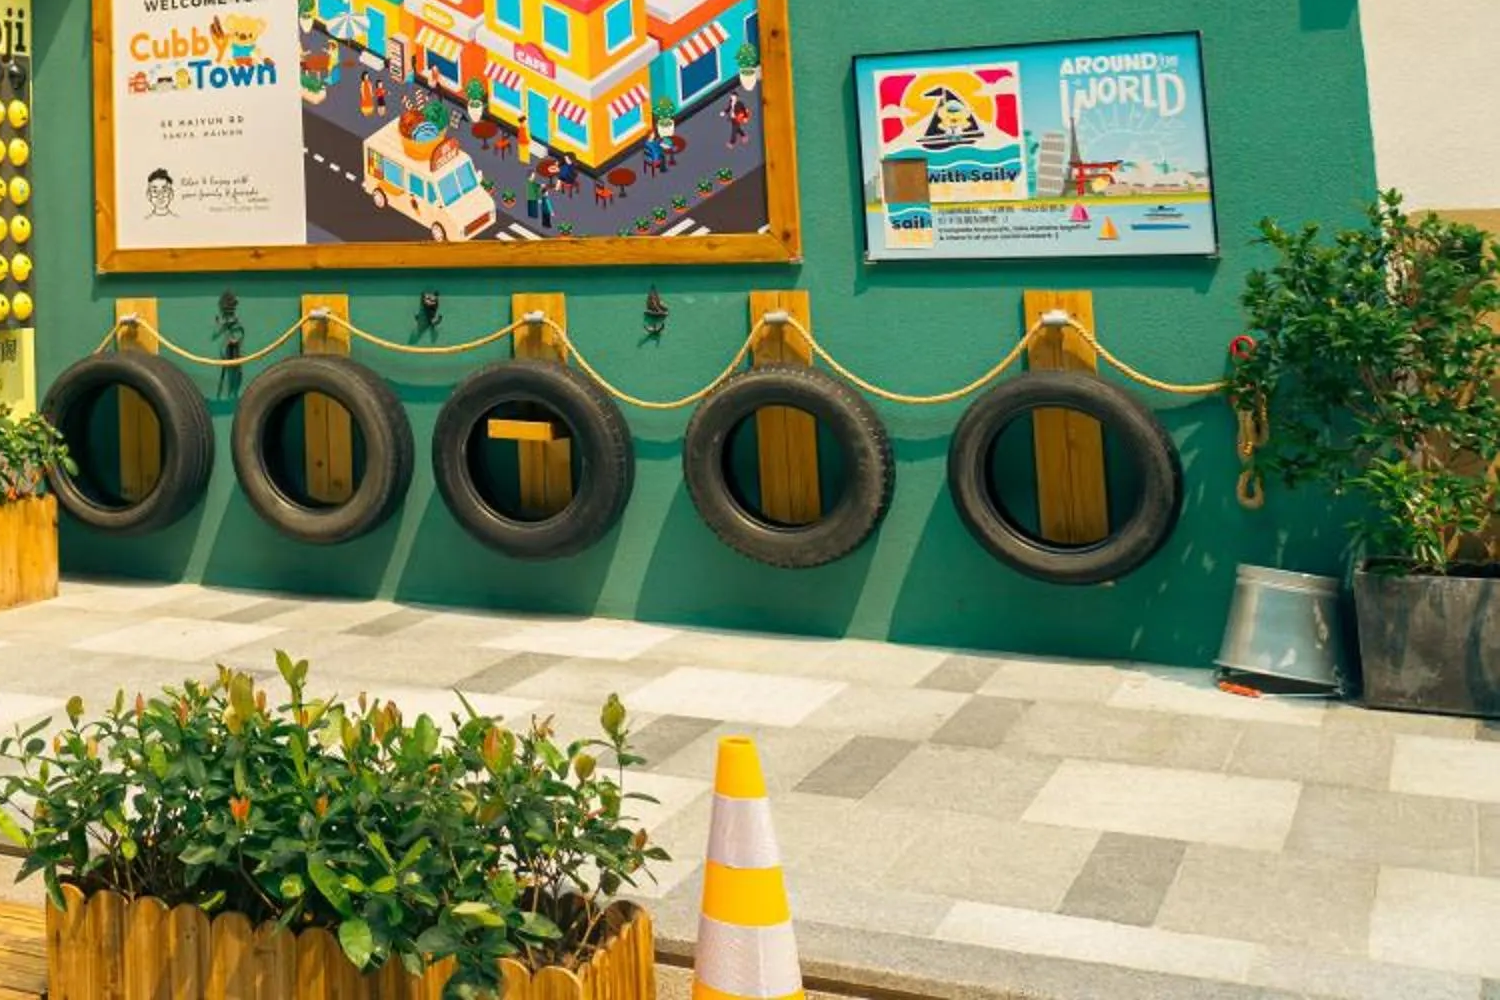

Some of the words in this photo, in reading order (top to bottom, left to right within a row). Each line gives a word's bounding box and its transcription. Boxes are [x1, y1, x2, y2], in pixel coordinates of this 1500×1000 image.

[129, 24, 232, 62] Cubby
[187, 59, 277, 90] Town
[1059, 52, 1157, 76] AROUND
[1059, 72, 1186, 128] WORLD
[928, 168, 967, 184] with
[970, 167, 1019, 183] Saily
